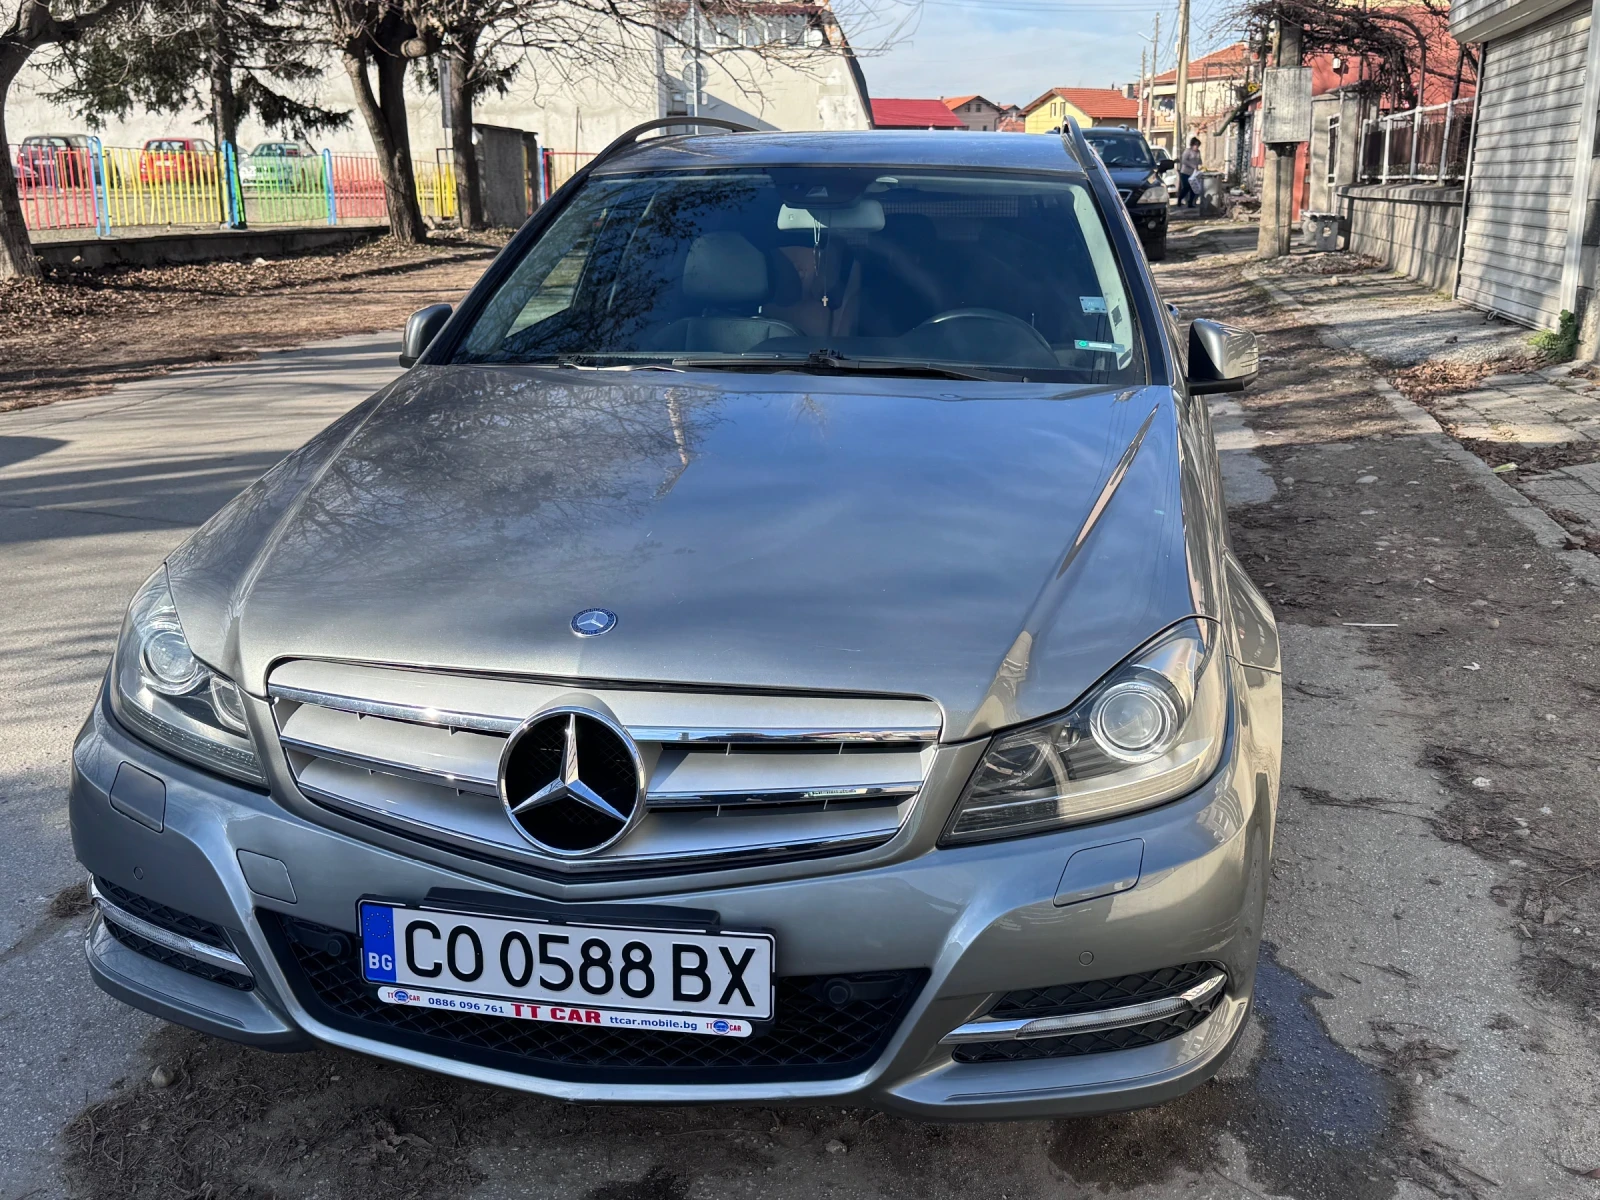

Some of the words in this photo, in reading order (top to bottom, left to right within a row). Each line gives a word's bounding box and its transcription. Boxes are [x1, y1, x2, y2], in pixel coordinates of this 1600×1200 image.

[368, 952, 393, 971] BG
[405, 919, 484, 982] CO
[500, 930, 655, 998] 0588
[672, 943, 756, 1007] BX
[409, 994, 421, 1002] CAR
[428, 997, 456, 1008] 0886
[459, 1001, 480, 1010] 096
[484, 1004, 504, 1013] 761
[510, 1003, 541, 1018] TT
[550, 1008, 601, 1024] CAR
[609, 1016, 698, 1031] ttcar.mobile.bg
[729, 1024, 742, 1032] CAR
